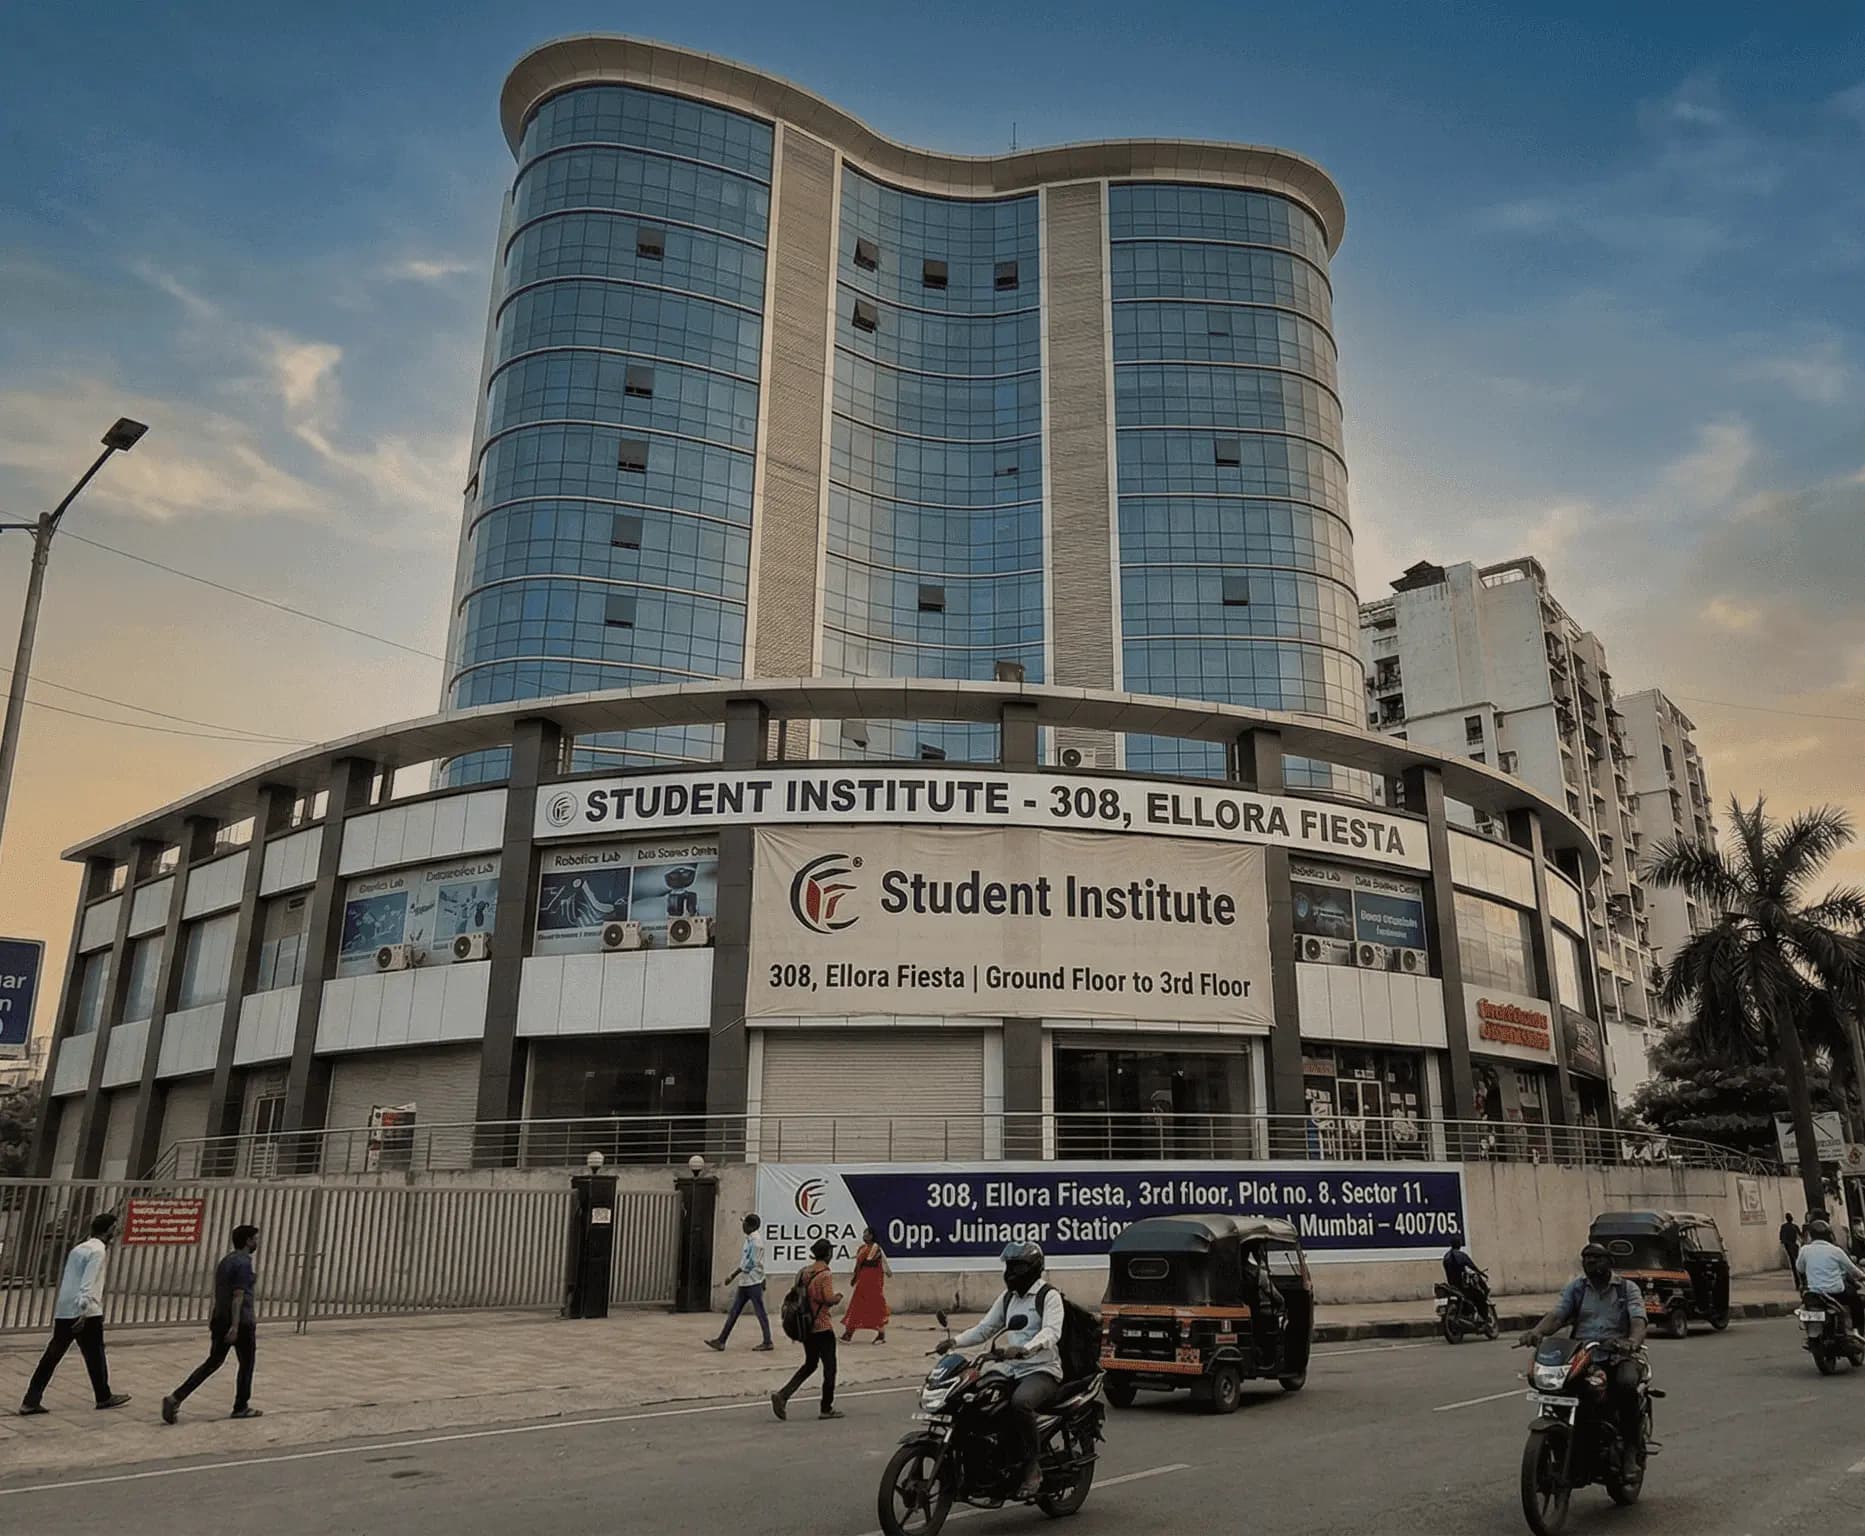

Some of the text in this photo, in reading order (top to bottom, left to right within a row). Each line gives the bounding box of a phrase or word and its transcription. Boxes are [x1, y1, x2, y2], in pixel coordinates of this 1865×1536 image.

[585, 780, 772, 823] STUDENT
[786, 779, 1009, 814] INSTITUTE
[1049, 785, 1133, 828] 308,
[1147, 792, 1290, 837] ELLORA
[1300, 809, 1407, 856] FIESTA
[881, 870, 1236, 925] Student Institute
[769, 964, 817, 993] 308,
[826, 964, 889, 988] Ellora
[898, 965, 965, 988] Fiesta
[986, 966, 1064, 990] Ground
[1073, 967, 1127, 992] Floor
[1133, 971, 1153, 993] to
[1160, 971, 1194, 995] 3rd
[1200, 973, 1251, 998] Floor
[927, 1183, 977, 1210] 308,
[986, 1182, 1050, 1207] Ellora
[1058, 1181, 1131, 1208] Fiesta,
[1139, 1181, 1174, 1205] 3rd
[1180, 1181, 1232, 1206] floor,
[1239, 1181, 1278, 1205] Plot
[1283, 1186, 1313, 1204] no.
[1342, 1181, 1398, 1204] Sector
[766, 1223, 857, 1241] ELLORA
[888, 1218, 941, 1249] Opp.
[948, 1217, 1050, 1242] Juinagar
[1057, 1216, 1133, 1241] Statio
[1300, 1212, 1374, 1237] Mumbai
